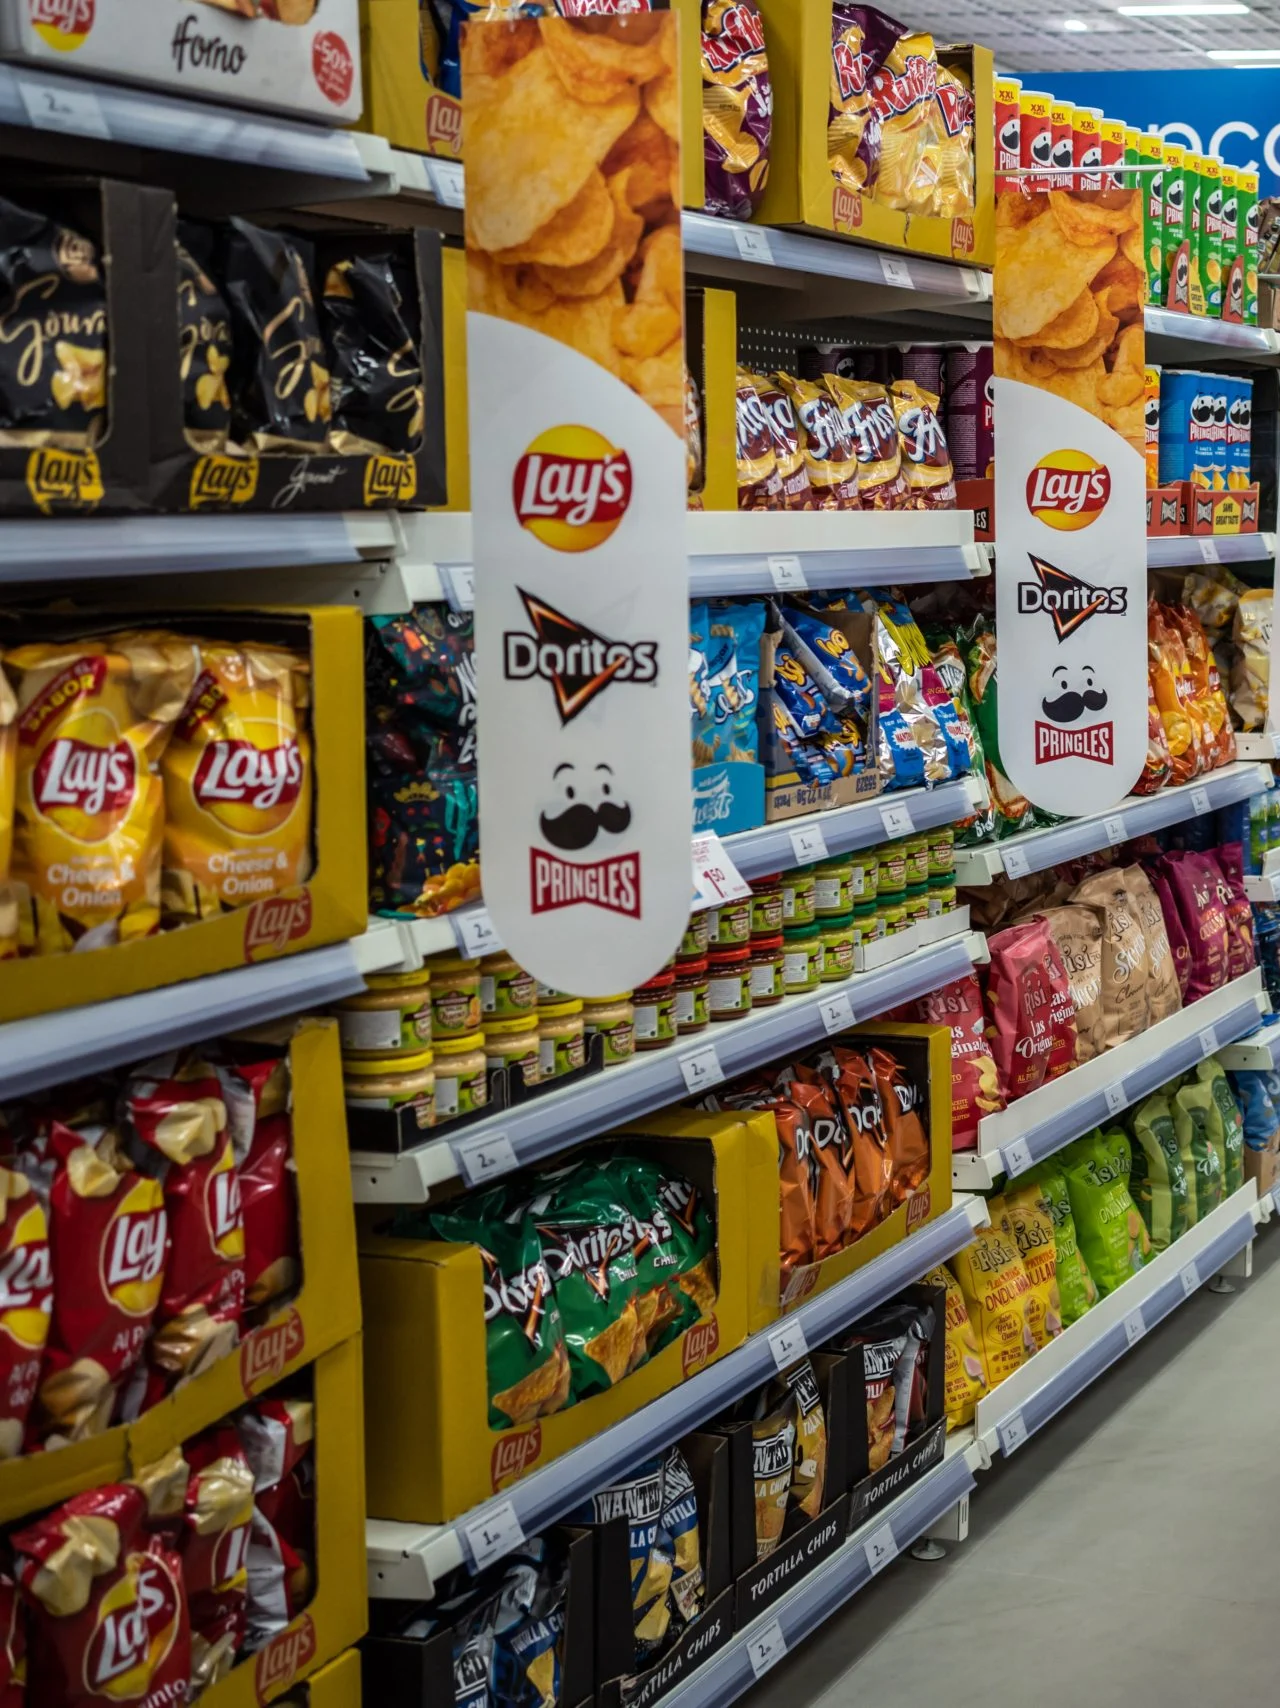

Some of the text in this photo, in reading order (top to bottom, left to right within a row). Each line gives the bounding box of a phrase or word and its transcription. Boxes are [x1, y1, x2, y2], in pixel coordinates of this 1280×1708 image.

[999, 91, 1014, 99] XXL
[1031, 104, 1045, 112] XXL
[1052, 112, 1065, 120] XXL
[430, 97, 461, 153] Lay
[1081, 121, 1094, 129] XXL
[1000, 151, 1020, 170] PRIN
[1167, 156, 1179, 164] XXL
[1166, 207, 1183, 223] PRIN
[34, 449, 93, 499] Lay's
[198, 457, 257, 500] Lay's
[369, 457, 414, 500] Lay's
[520, 453, 628, 527] Lay's
[1031, 467, 1106, 515] Lay's
[1018, 582, 1128, 614] Doritos
[506, 631, 658, 682] Doritos
[1039, 726, 1110, 761] PRINGLES
[41, 739, 127, 815] Lay's
[200, 739, 299, 808] Lay's
[47, 863, 118, 885] Cheese
[207, 853, 288, 874] Cheese &
[534, 857, 638, 910] PRINGLES
[62, 887, 121, 907] Onion
[223, 876, 273, 895] Onion
[248, 896, 309, 951] Lay's
[108, 1212, 170, 1284] Lay
[244, 1318, 299, 1382] Lay's
[686, 1320, 716, 1364] Lay's
[495, 1432, 540, 1480] Lay's
[864, 1464, 910, 1506] TORTILLA
[750, 1520, 838, 1601] TORTILLA CHIPS
[260, 1630, 312, 1691] Lay's
[687, 1619, 721, 1660] CHIPS
